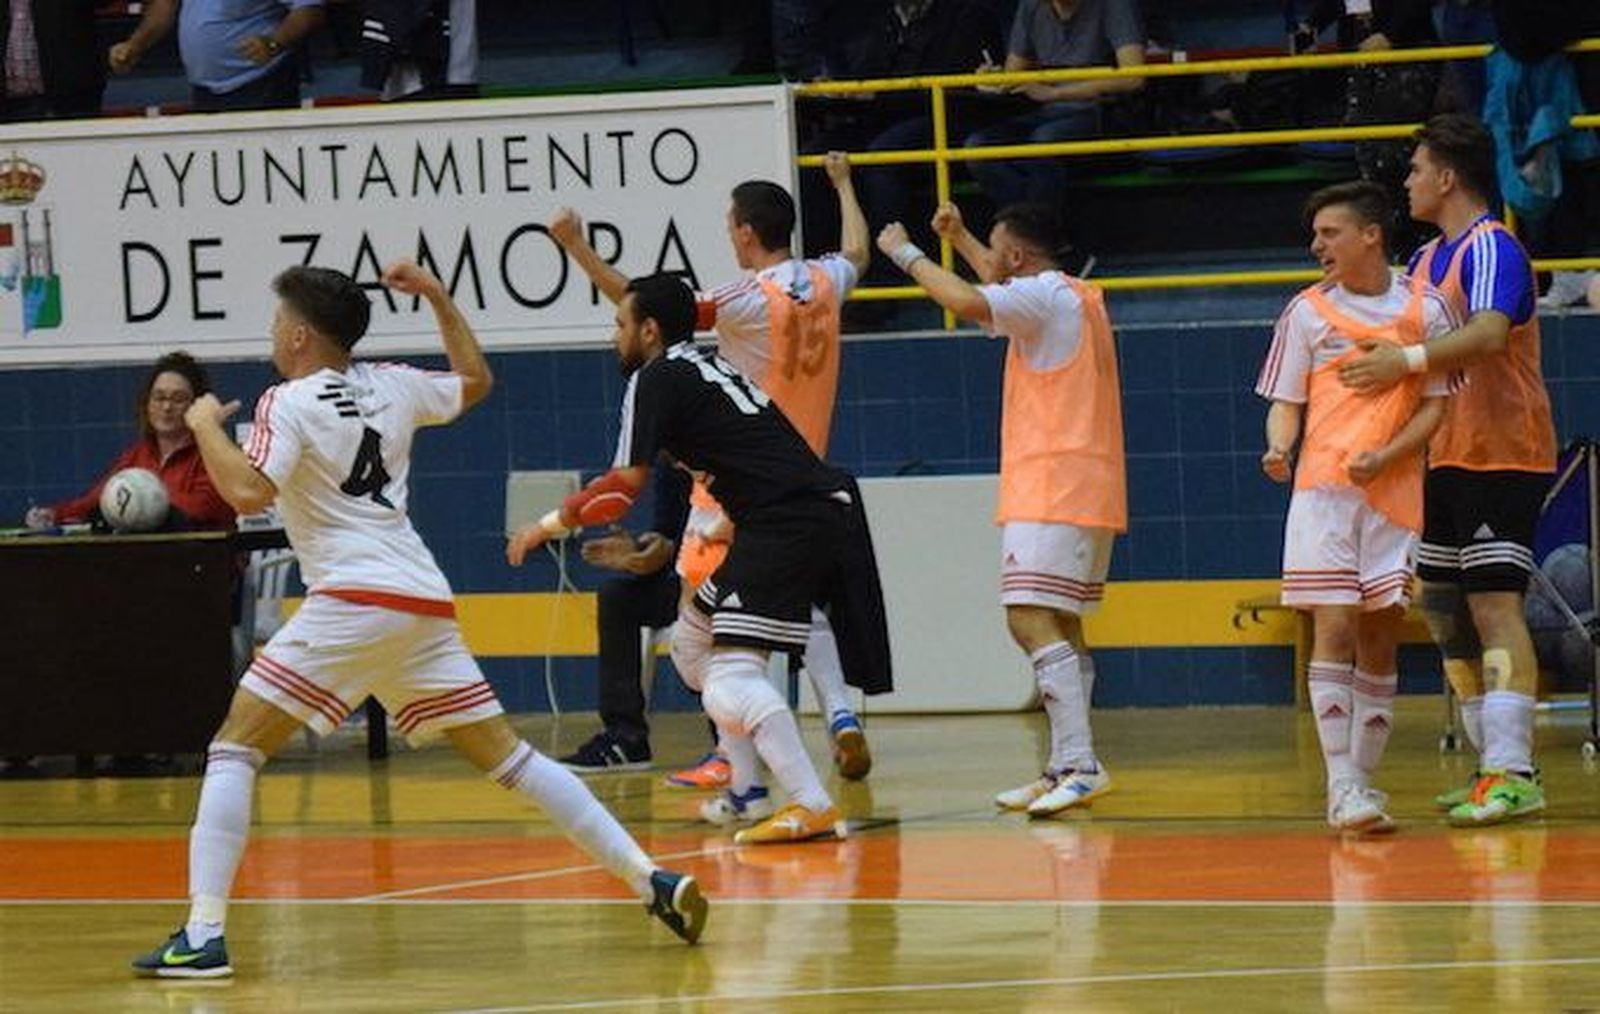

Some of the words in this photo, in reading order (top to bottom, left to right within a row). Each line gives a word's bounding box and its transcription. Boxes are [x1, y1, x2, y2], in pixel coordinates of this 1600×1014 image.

[119, 127, 699, 210] AYUNTAMIENTO
[121, 237, 226, 324] DE
[339, 426, 396, 510] 4
